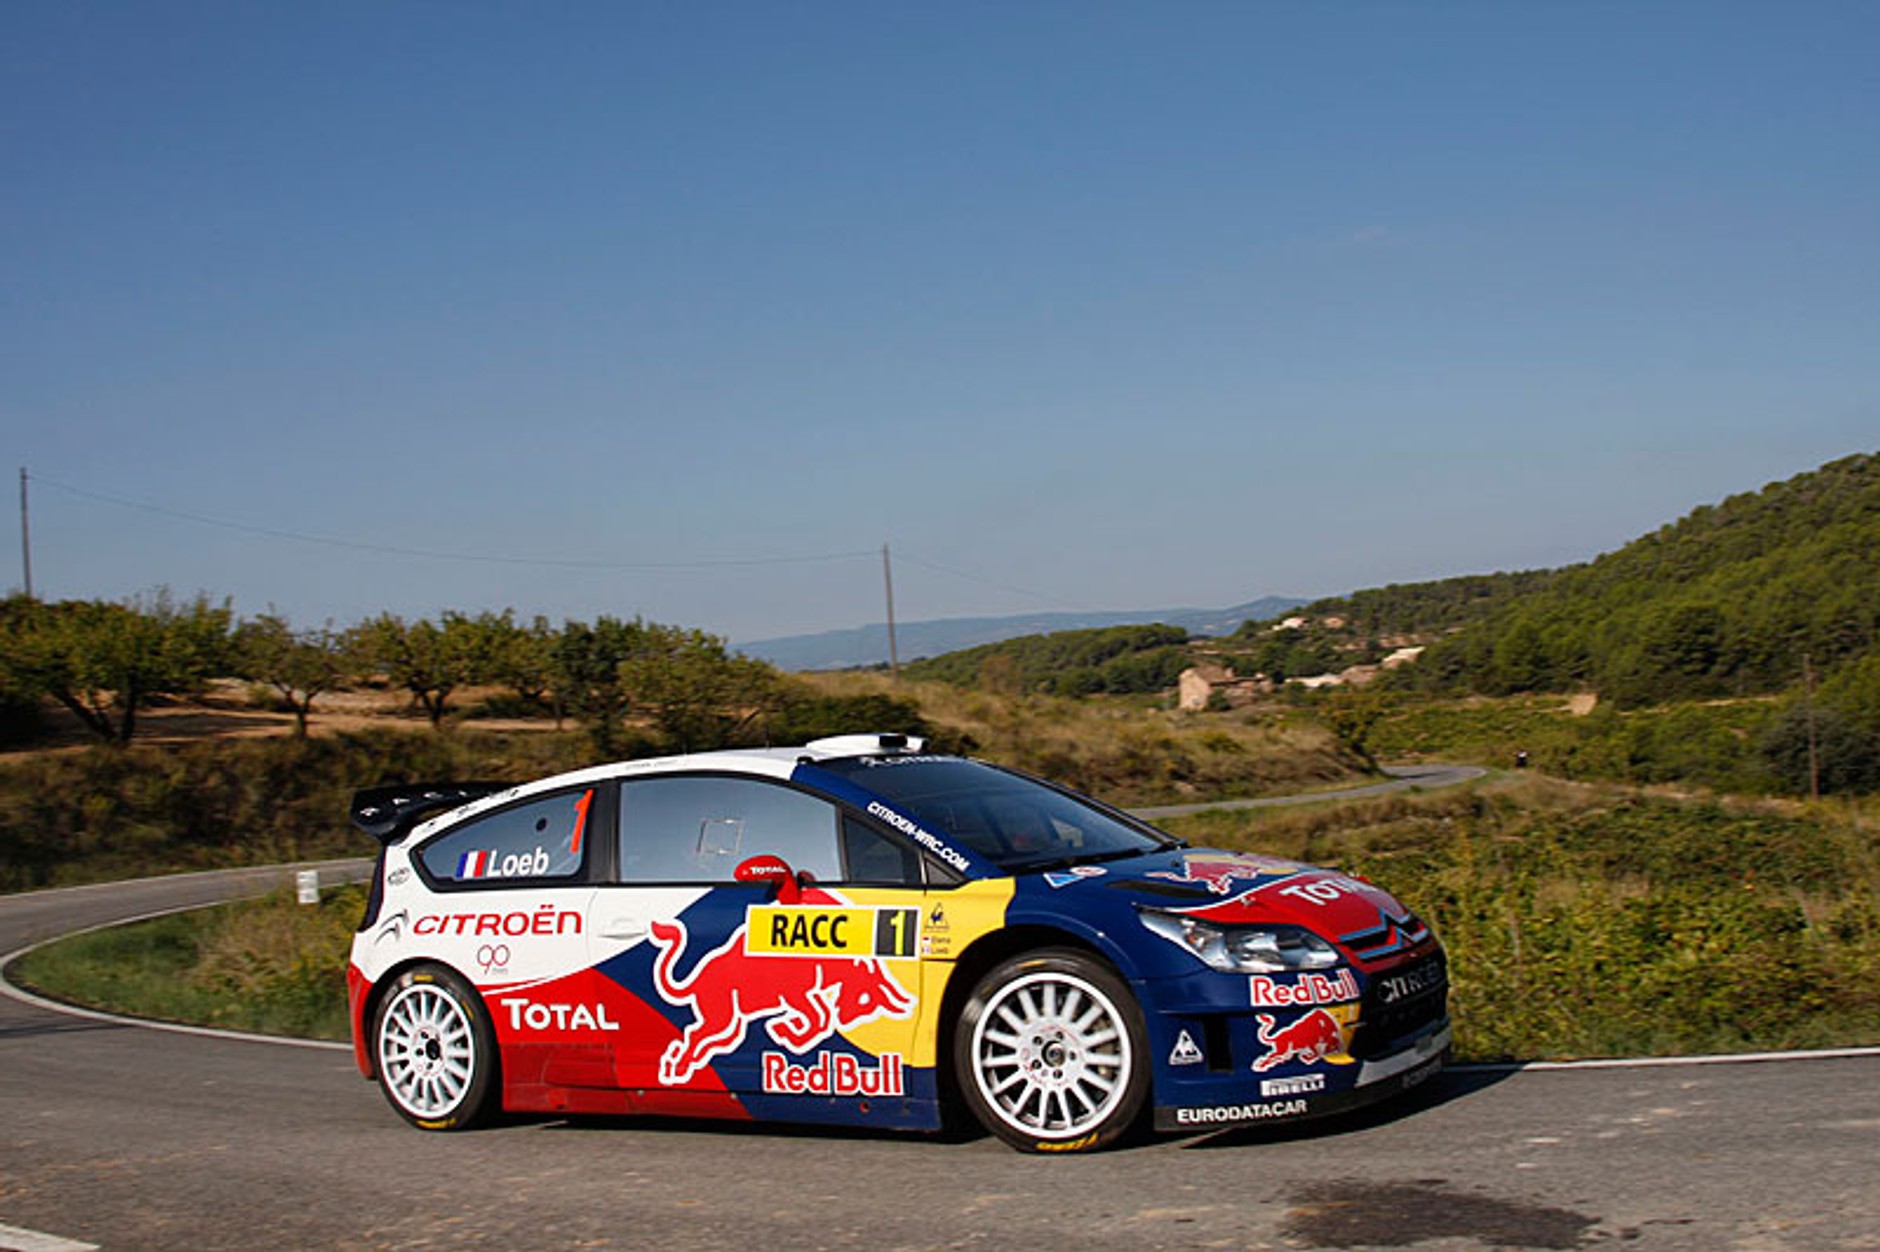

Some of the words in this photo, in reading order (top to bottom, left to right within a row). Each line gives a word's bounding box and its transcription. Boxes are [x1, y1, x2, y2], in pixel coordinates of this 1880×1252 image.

[572, 789, 594, 854] 1
[487, 847, 549, 877] Loeb
[750, 866, 787, 876] TOTAL
[413, 904, 582, 936] CITROËN
[771, 914, 848, 949] RACC
[889, 910, 906, 956] 1
[477, 944, 511, 975] 90
[1250, 973, 1316, 1006] Red
[1313, 967, 1361, 1002] Bull
[500, 998, 620, 1031] TOTAL
[762, 1051, 832, 1095] Red
[833, 1052, 904, 1096] Bull
[1261, 1073, 1325, 1097] PIRELLI
[1177, 1099, 1307, 1123] EURODATACAR
